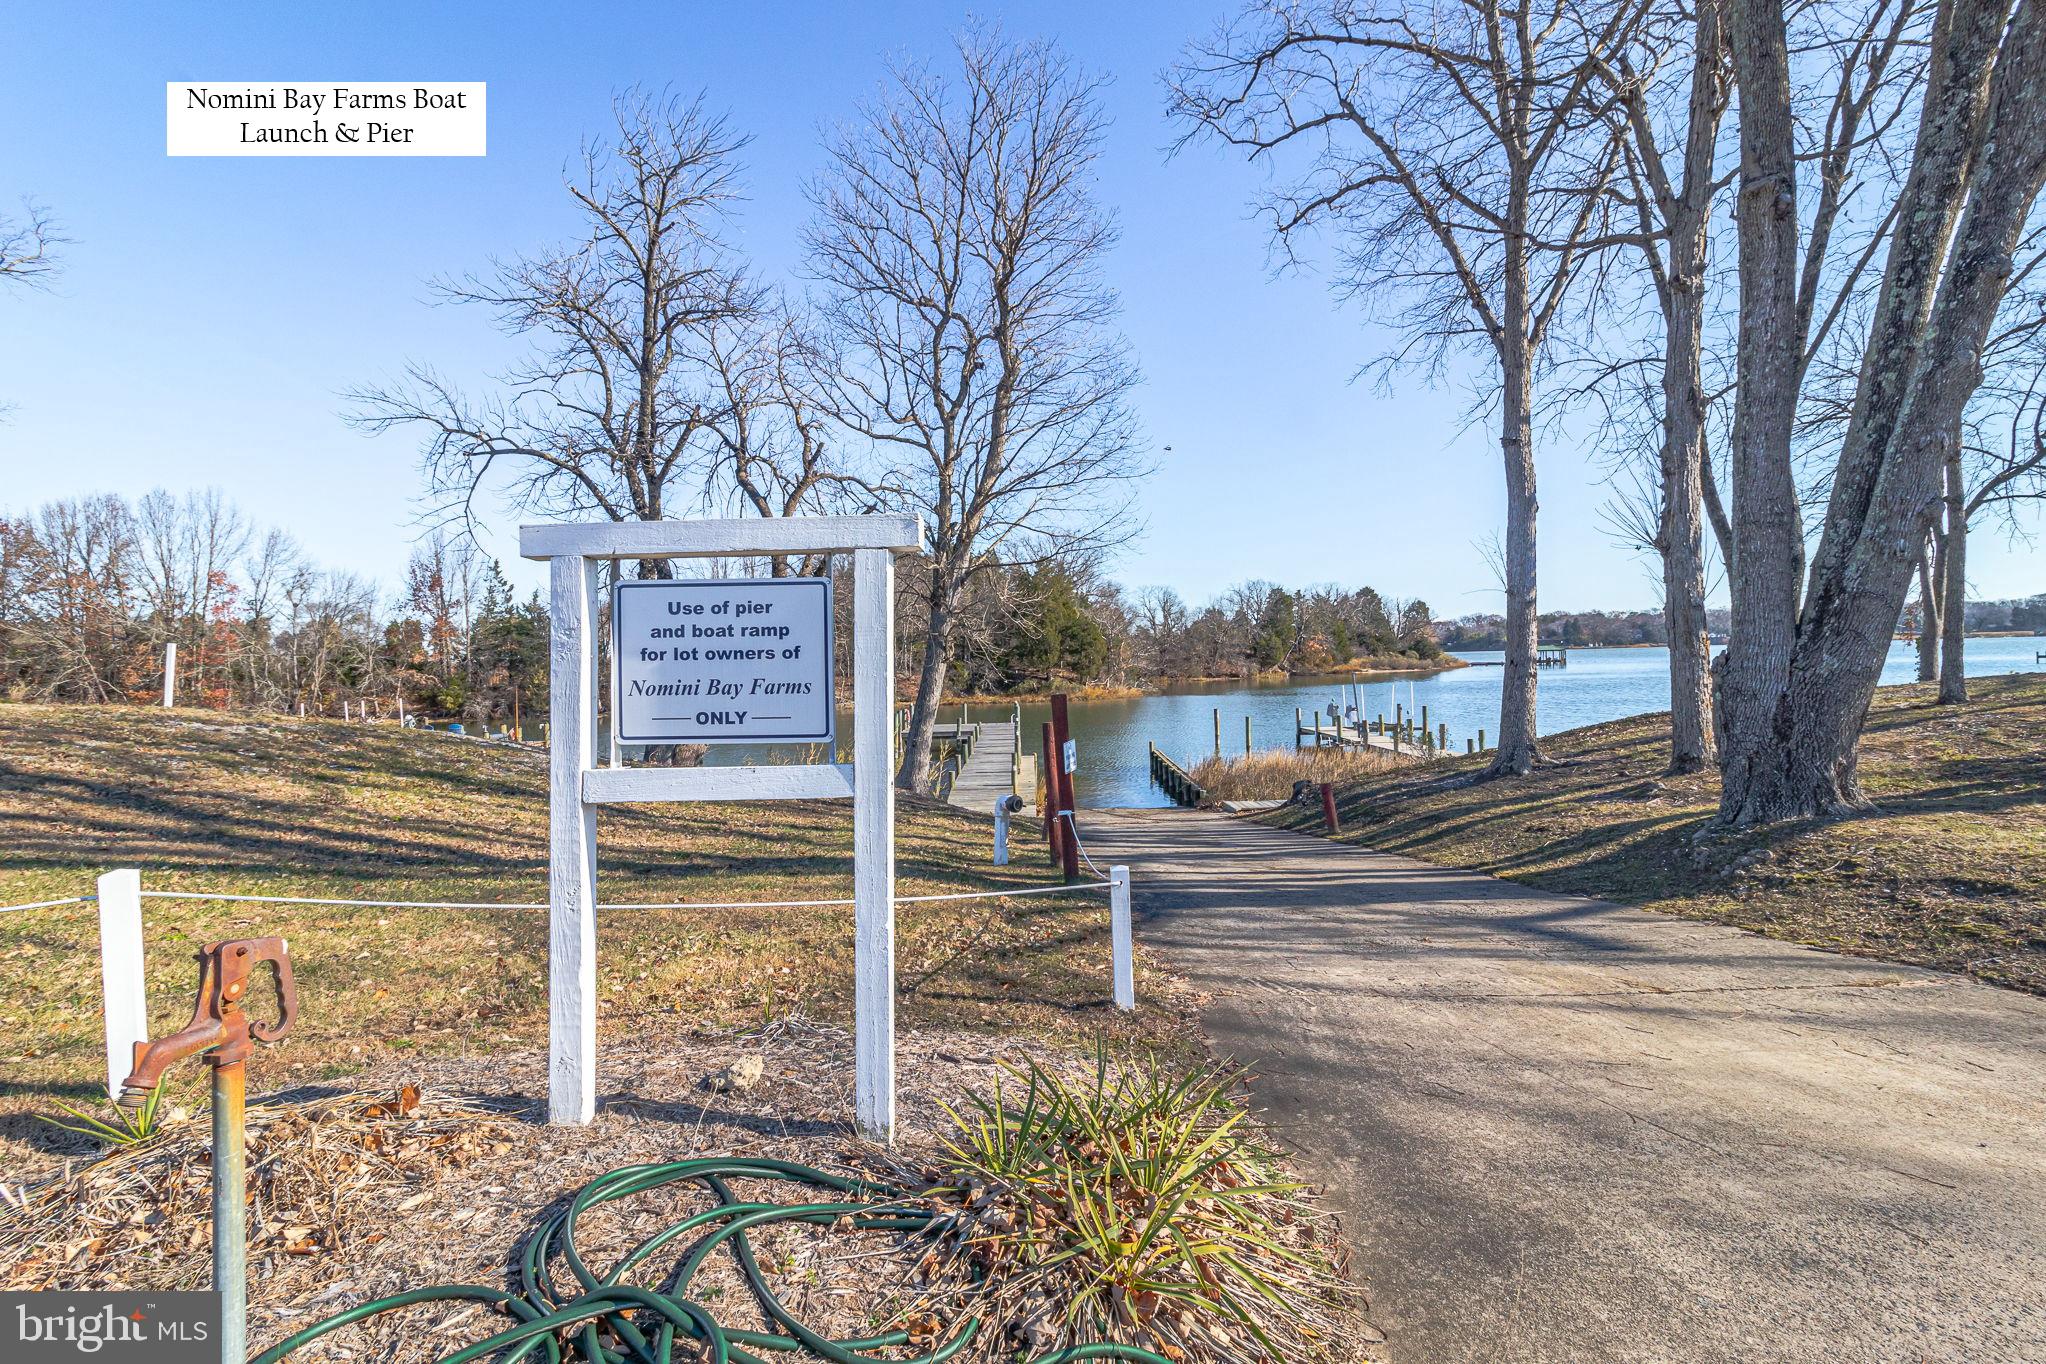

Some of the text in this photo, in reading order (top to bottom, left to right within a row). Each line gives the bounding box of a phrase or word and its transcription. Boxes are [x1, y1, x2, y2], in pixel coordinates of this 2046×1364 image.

[667, 600, 773, 617] Use of pier
[650, 624, 790, 640] and boat ramp
[640, 645, 801, 662] for lot owners of
[628, 677, 812, 700] Nomini Bay Farms
[695, 711, 748, 725] ONLY
